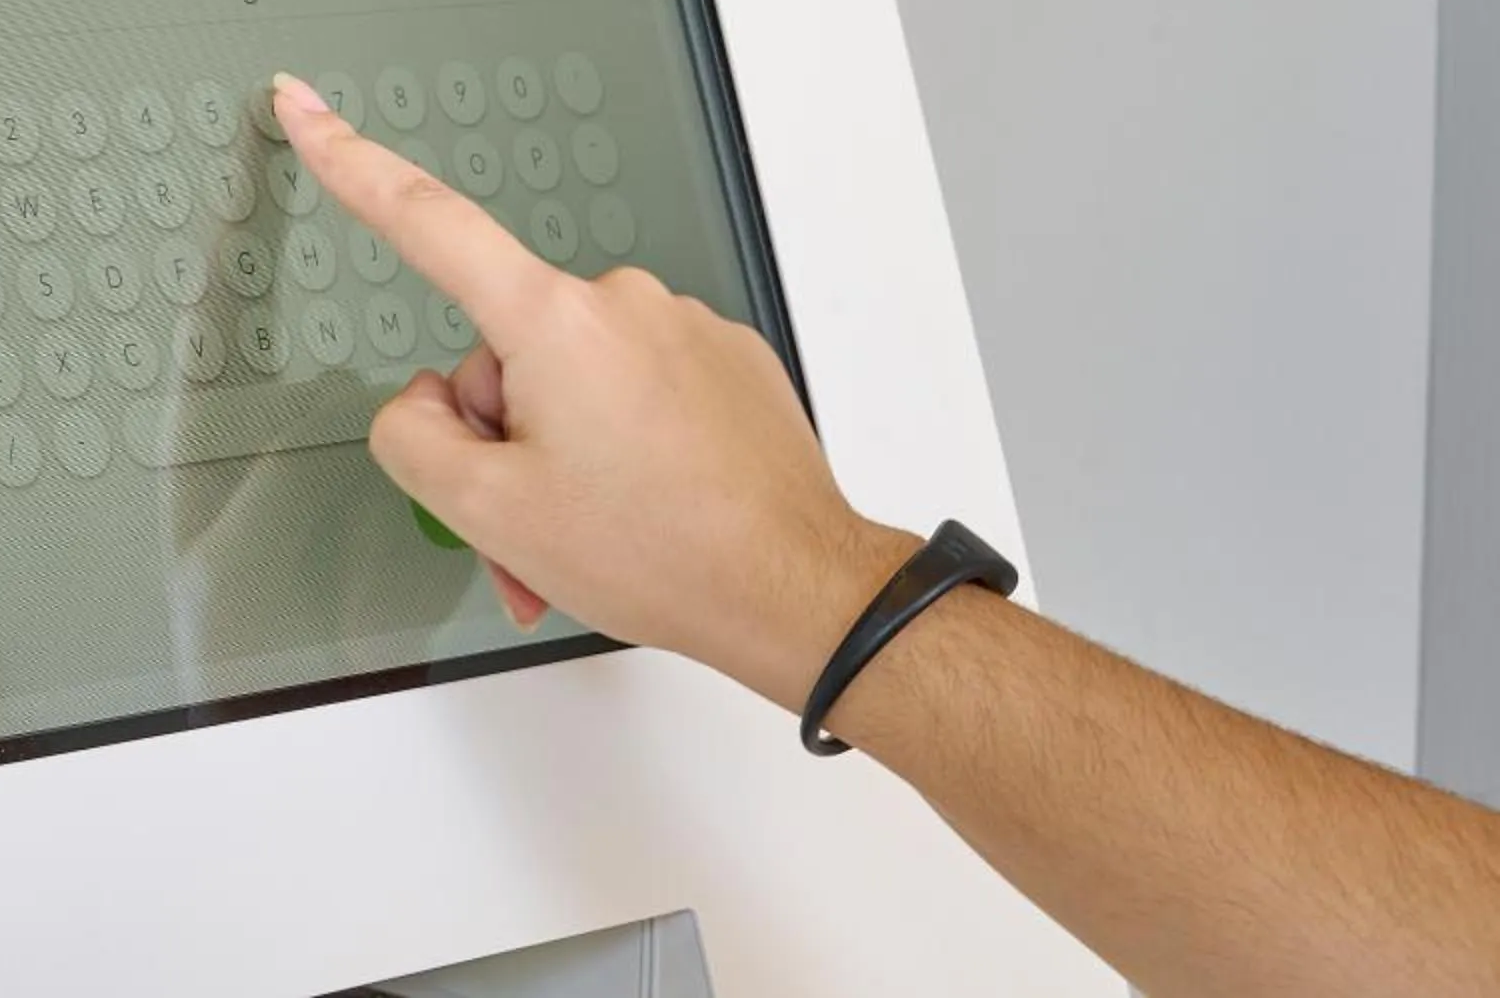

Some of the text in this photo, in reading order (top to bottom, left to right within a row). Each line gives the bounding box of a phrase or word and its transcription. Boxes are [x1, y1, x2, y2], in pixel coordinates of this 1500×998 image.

[3, 116, 21, 142] 2
[71, 111, 88, 136] 3
[140, 106, 153, 128] 4
[204, 101, 219, 126] 5
[393, 85, 408, 109] 8
[453, 80, 467, 104] 9
[512, 75, 528, 100] 0
[14, 195, 40, 220] W
[87, 187, 104, 214] E
[155, 182, 172, 205] R
[220, 175, 236, 200] T
[282, 168, 298, 192] Y
[469, 152, 487, 176] O
[530, 146, 544, 171] P
[105, 264, 123, 289] D
[173, 257, 186, 282] F
[236, 251, 256, 276] G
[303, 245, 320, 269] H
[54, 350, 72, 374] X
[122, 342, 141, 367] C
[189, 334, 204, 358] V
[255, 326, 272, 352] B
[318, 319, 338, 343] N
[378, 312, 402, 336] M
